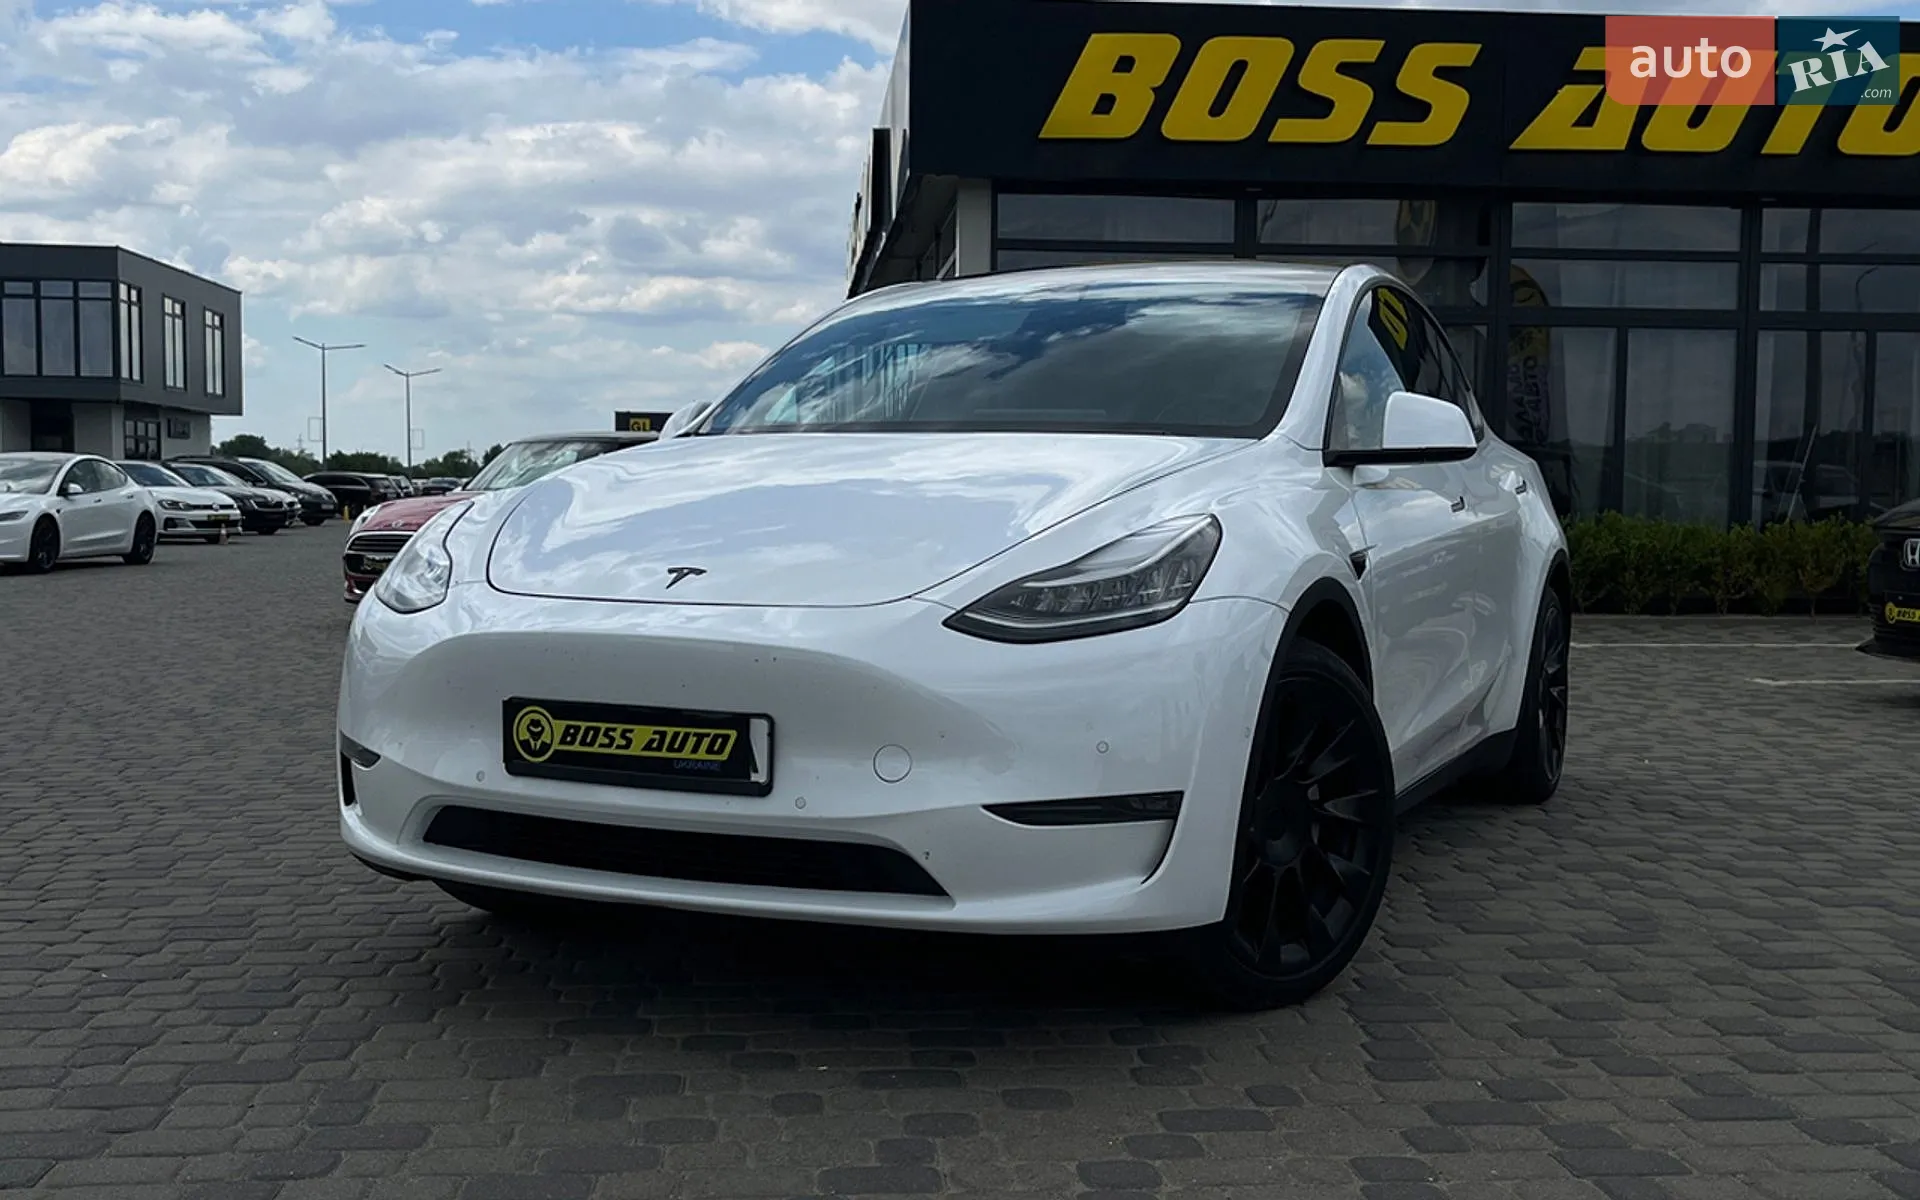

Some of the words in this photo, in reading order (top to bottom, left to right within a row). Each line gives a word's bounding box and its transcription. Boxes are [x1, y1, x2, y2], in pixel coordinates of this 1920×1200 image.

[1038, 32, 1482, 146] BOSS
[558, 724, 634, 750] BOSS
[641, 730, 730, 756] AUTO
